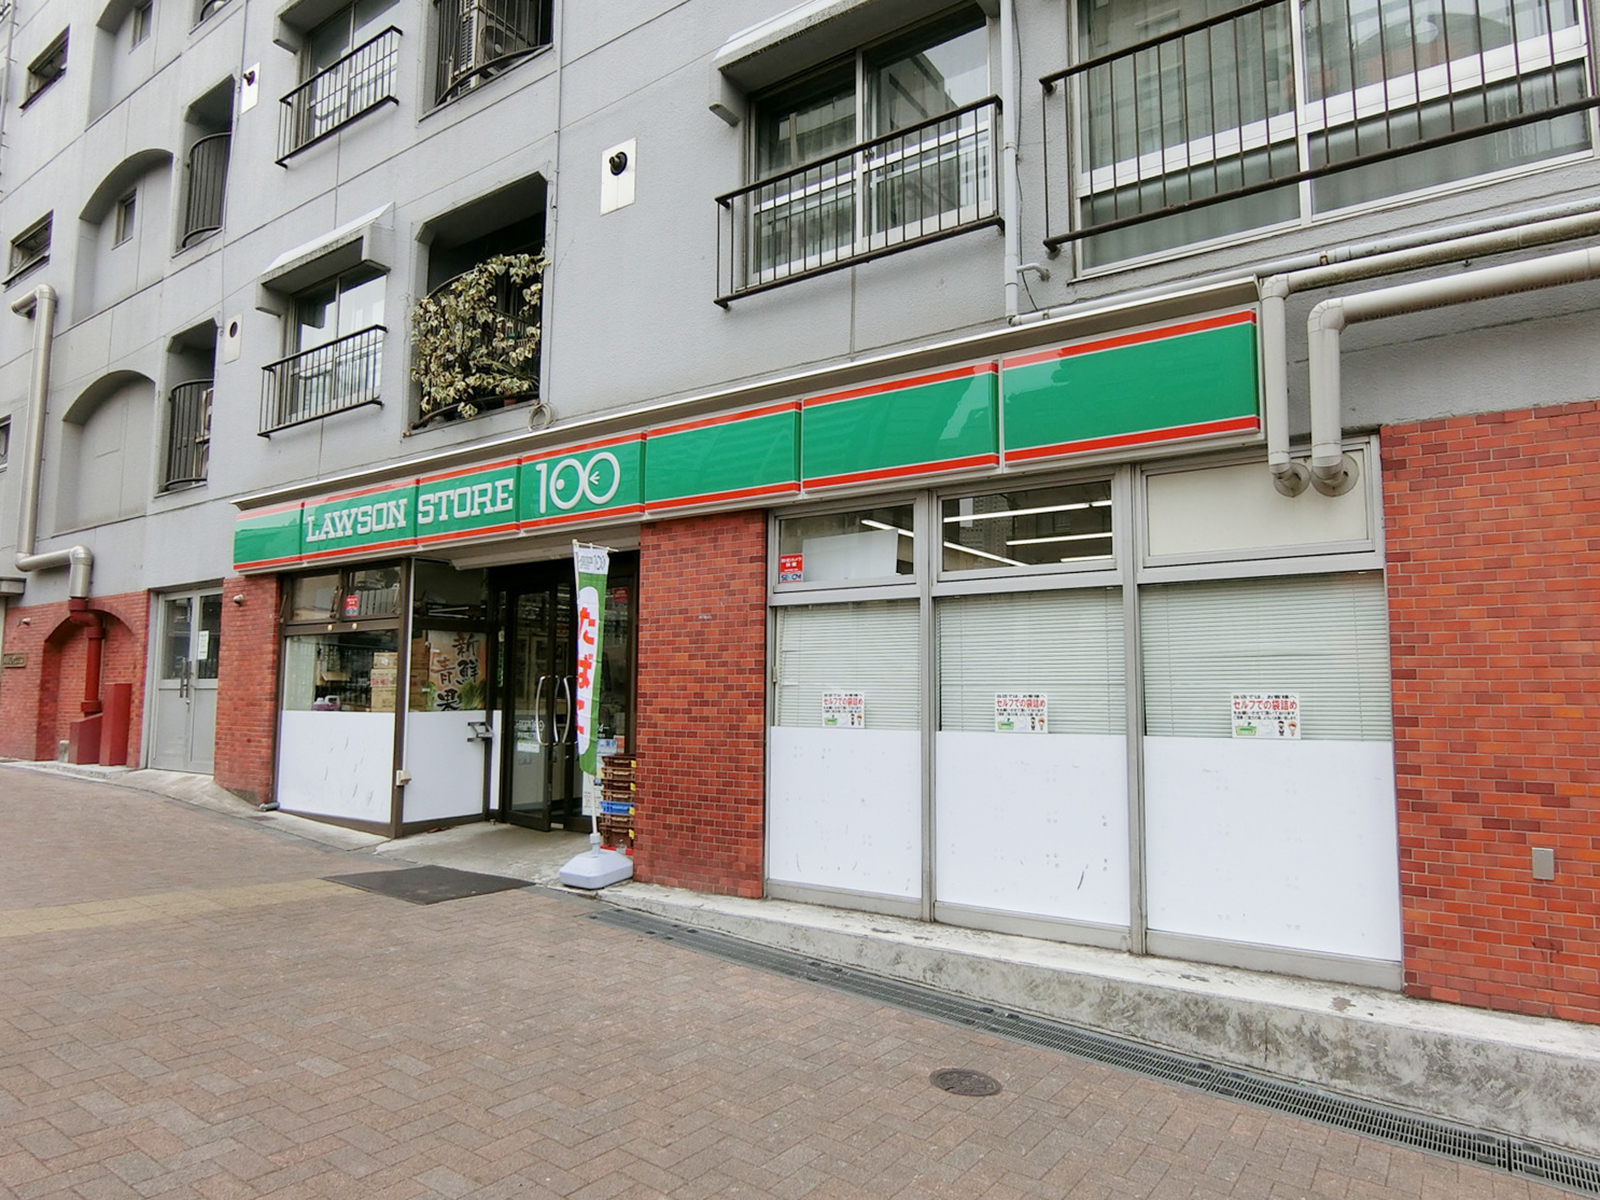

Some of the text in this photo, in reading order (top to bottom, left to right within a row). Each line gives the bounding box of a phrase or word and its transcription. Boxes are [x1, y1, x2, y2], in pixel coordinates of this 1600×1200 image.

[306, 452, 620, 543] LAWSON STORE 100
[430, 655, 462, 712] 青果
[452, 631, 480, 686] 新鮮
[1233, 700, 1297, 710] セルフでの袋詰め
